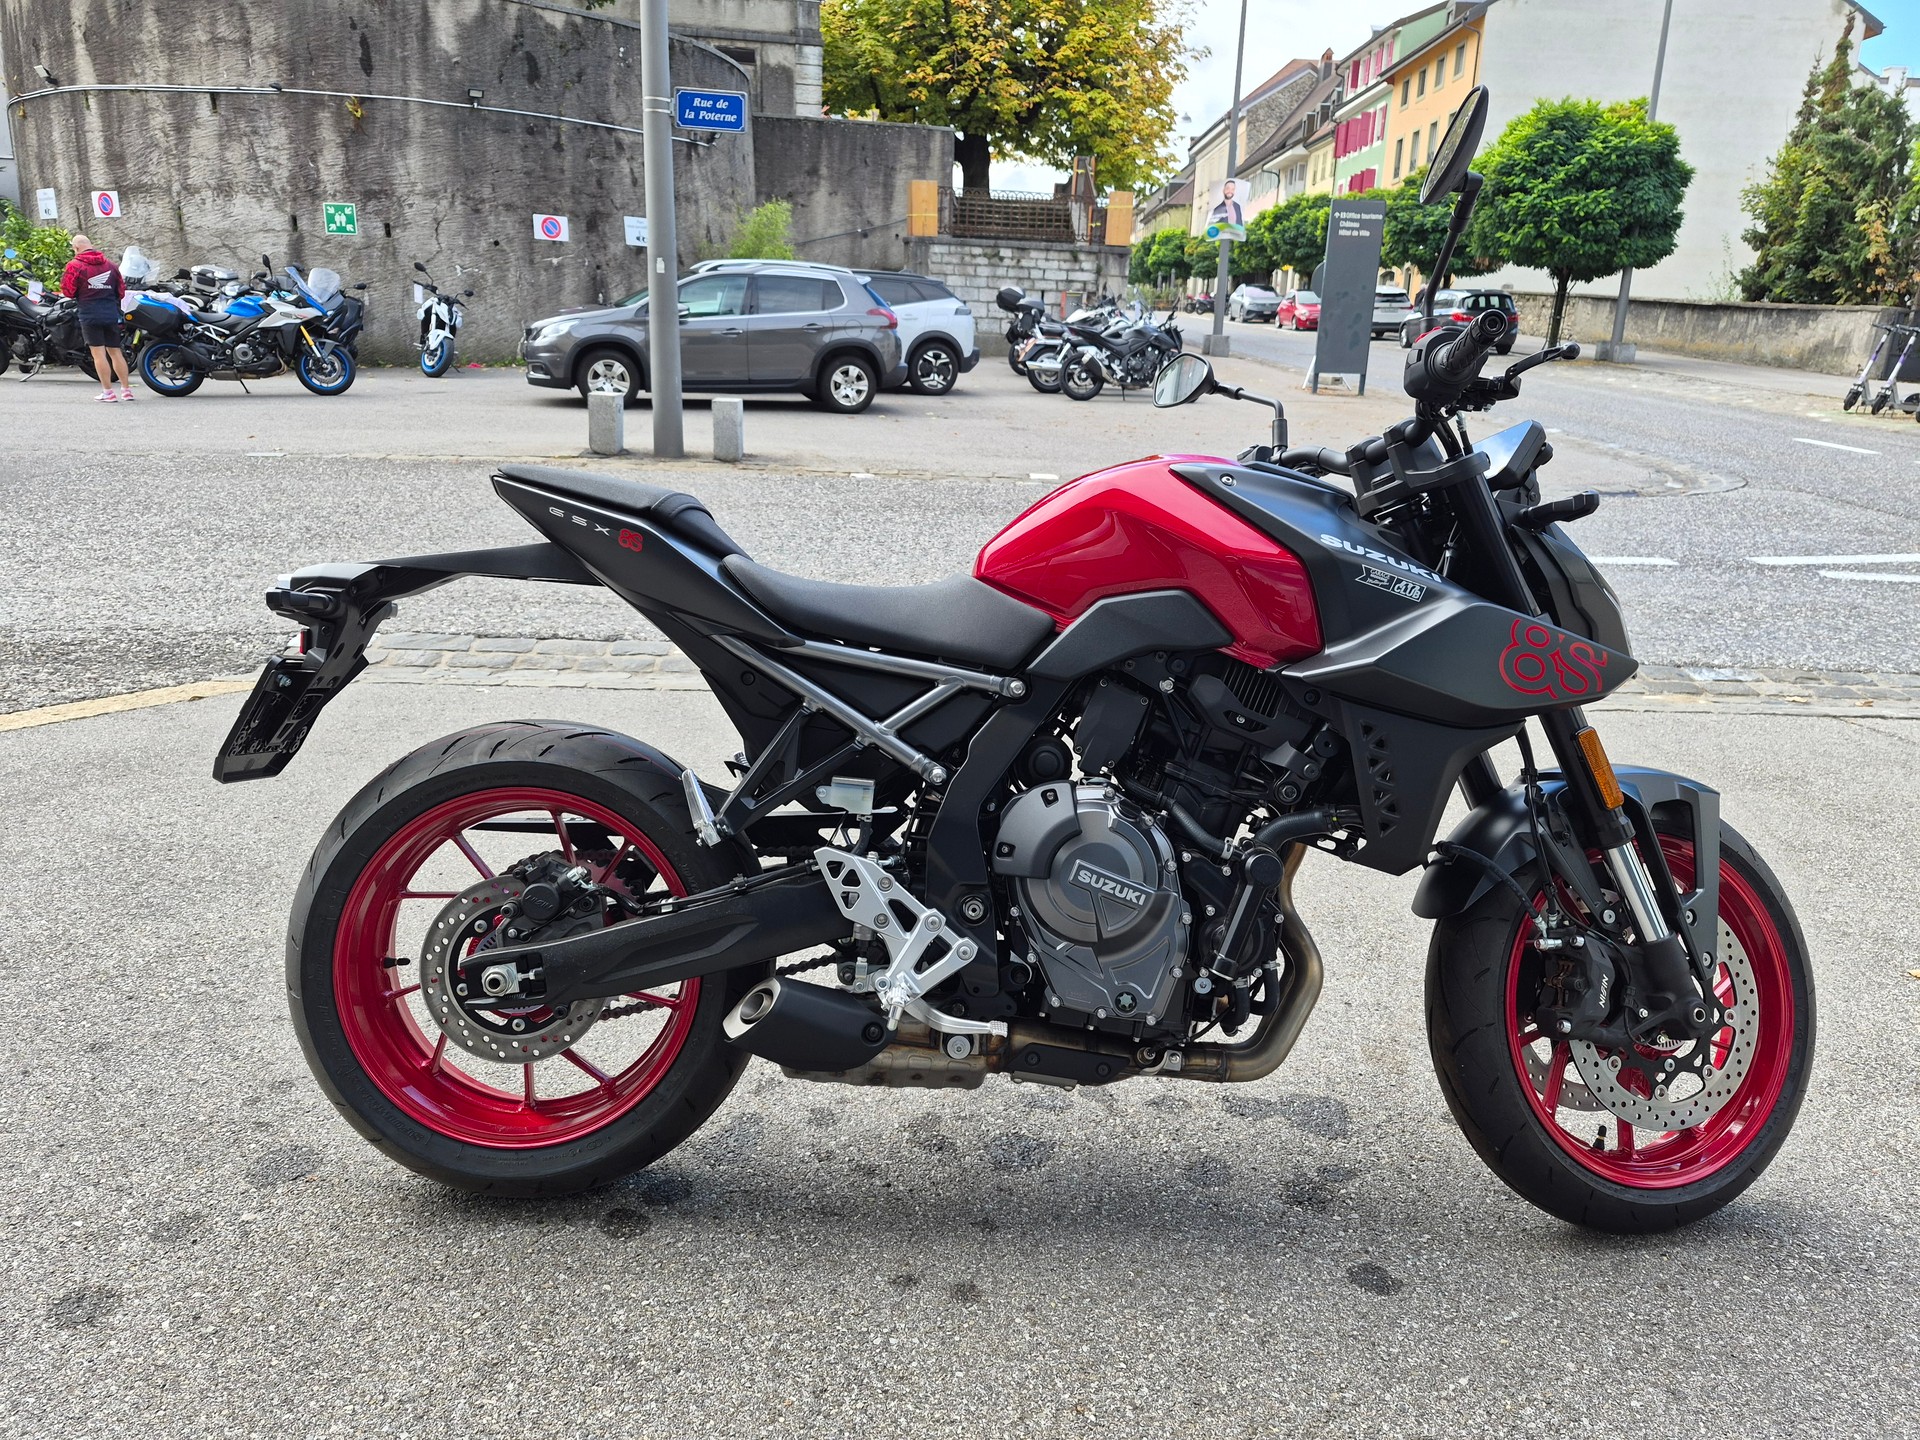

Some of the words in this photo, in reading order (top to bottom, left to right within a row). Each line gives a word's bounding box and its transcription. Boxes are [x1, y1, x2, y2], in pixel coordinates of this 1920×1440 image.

[684, 109, 695, 119] la
[699, 110, 737, 122] Poterne
[693, 97, 713, 108] Rue
[716, 99, 729, 109] de
[549, 506, 611, 537] GSX
[1320, 533, 1442, 583] SUZUKI
[1393, 580, 1421, 599] CLUB
[1077, 869, 1146, 906] SUZUKI
